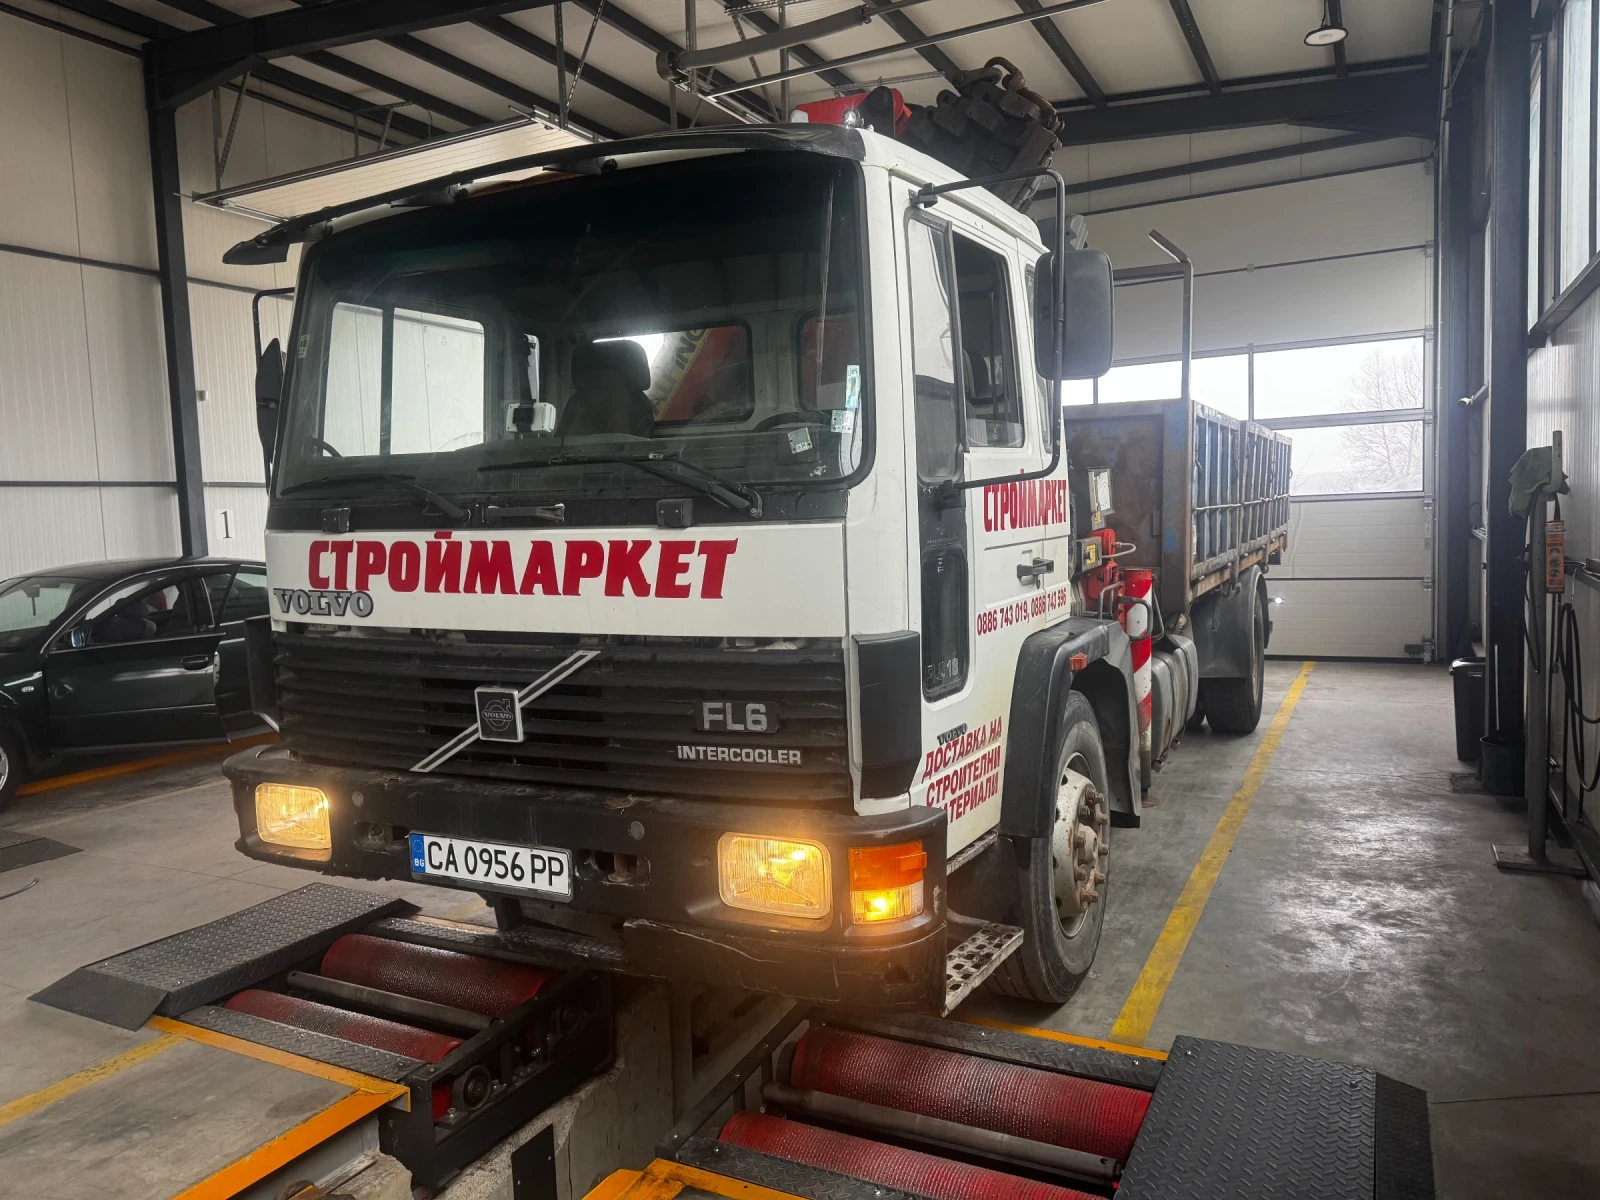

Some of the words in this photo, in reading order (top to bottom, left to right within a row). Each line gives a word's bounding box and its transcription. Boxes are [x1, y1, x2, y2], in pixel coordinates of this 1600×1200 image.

[219, 510, 233, 539] 1
[308, 531, 738, 599] СТРОЙМАРКЕТ
[273, 588, 374, 618] VOLVO
[976, 609, 998, 637] 0886
[1000, 604, 1014, 629] 743
[1015, 599, 1030, 624] 019,
[483, 711, 512, 720] VOLVO
[702, 702, 768, 731] FL6
[677, 745, 801, 765] INTERCOOLER
[921, 724, 987, 784] ДОСТАВКА
[987, 716, 1003, 743] НА
[926, 745, 1002, 807] СТРОИТЕЛНИ
[943, 771, 1000, 824] ТЕРИАЛИ
[414, 858, 425, 867] BG
[427, 841, 459, 873] CA
[464, 845, 525, 882] 0956
[530, 853, 565, 886] PP
